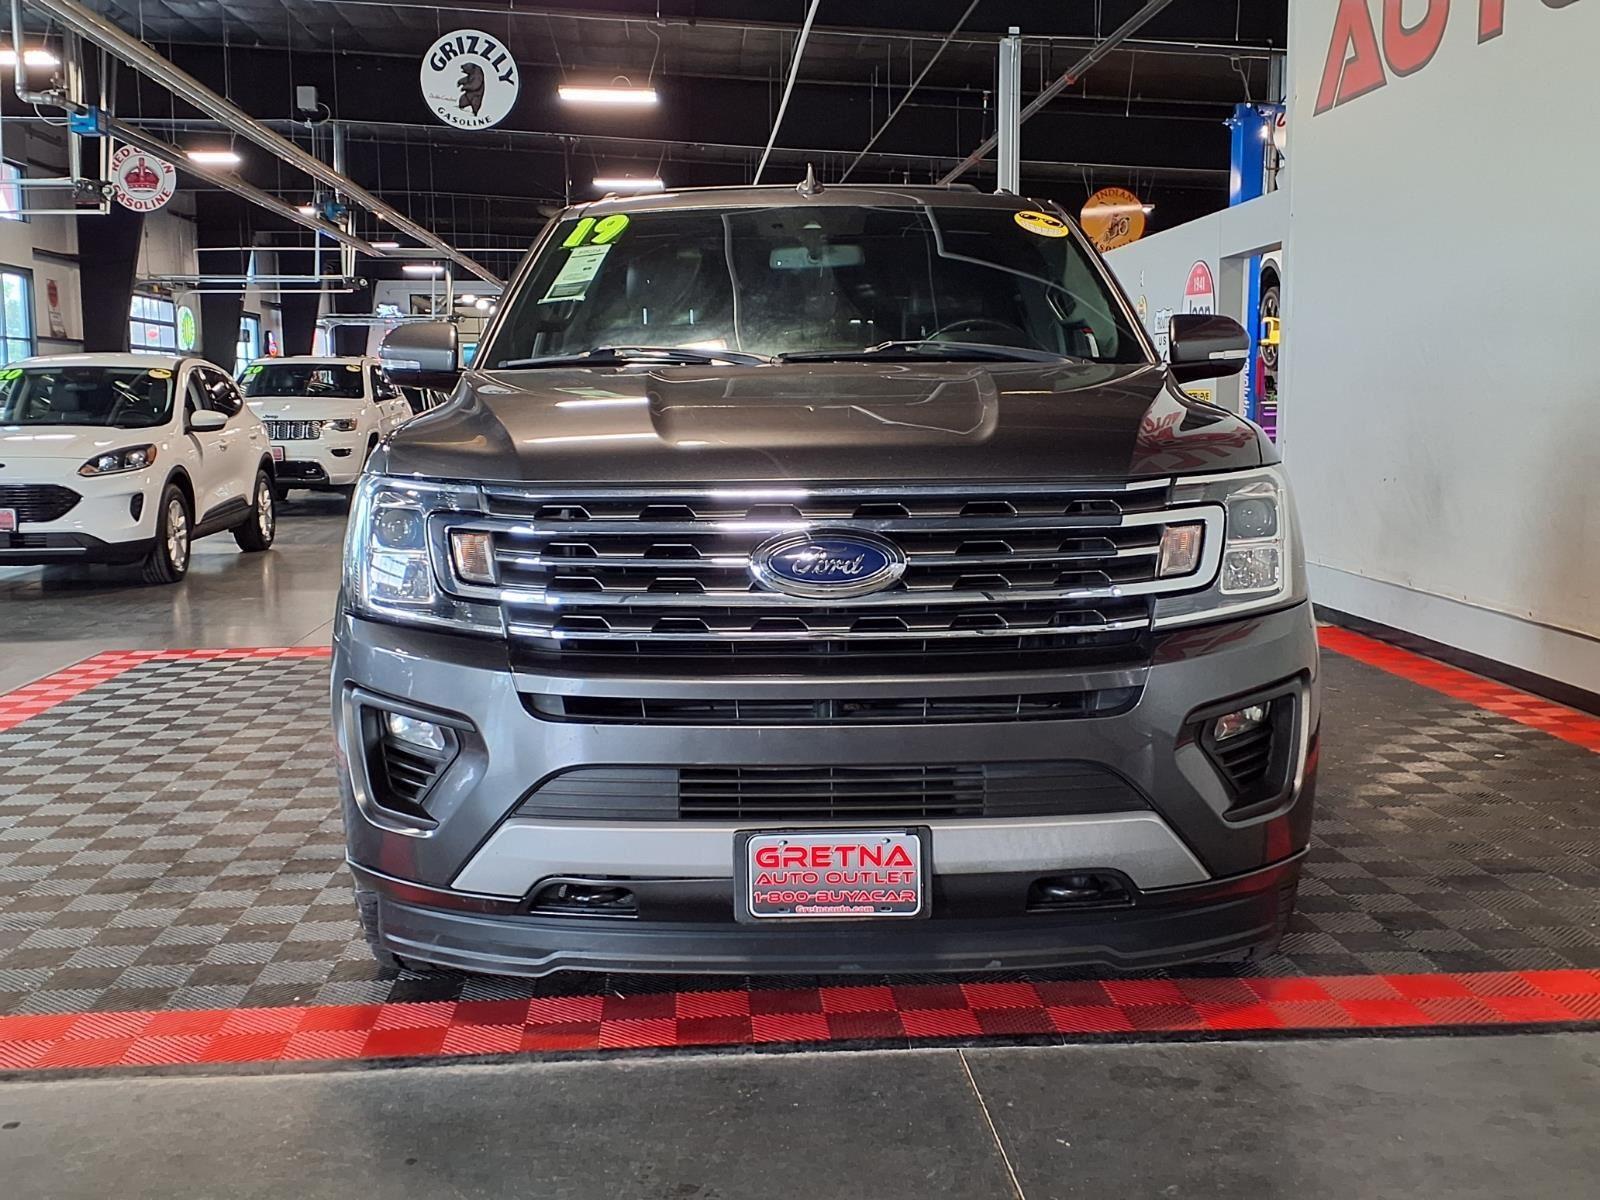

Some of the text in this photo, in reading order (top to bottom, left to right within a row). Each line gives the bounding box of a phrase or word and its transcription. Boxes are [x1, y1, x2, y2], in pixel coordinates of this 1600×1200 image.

[430, 35, 515, 86] GRIZZLY
[437, 106, 493, 127] GASOLINE
[1096, 189, 1135, 202] INDIAN
[563, 214, 630, 248] 19
[791, 546, 865, 575] Ford
[755, 844, 914, 868] GRETNA
[755, 871, 915, 886] AUTO OUTLET
[754, 890, 916, 904] 1-800-BUYACAR
